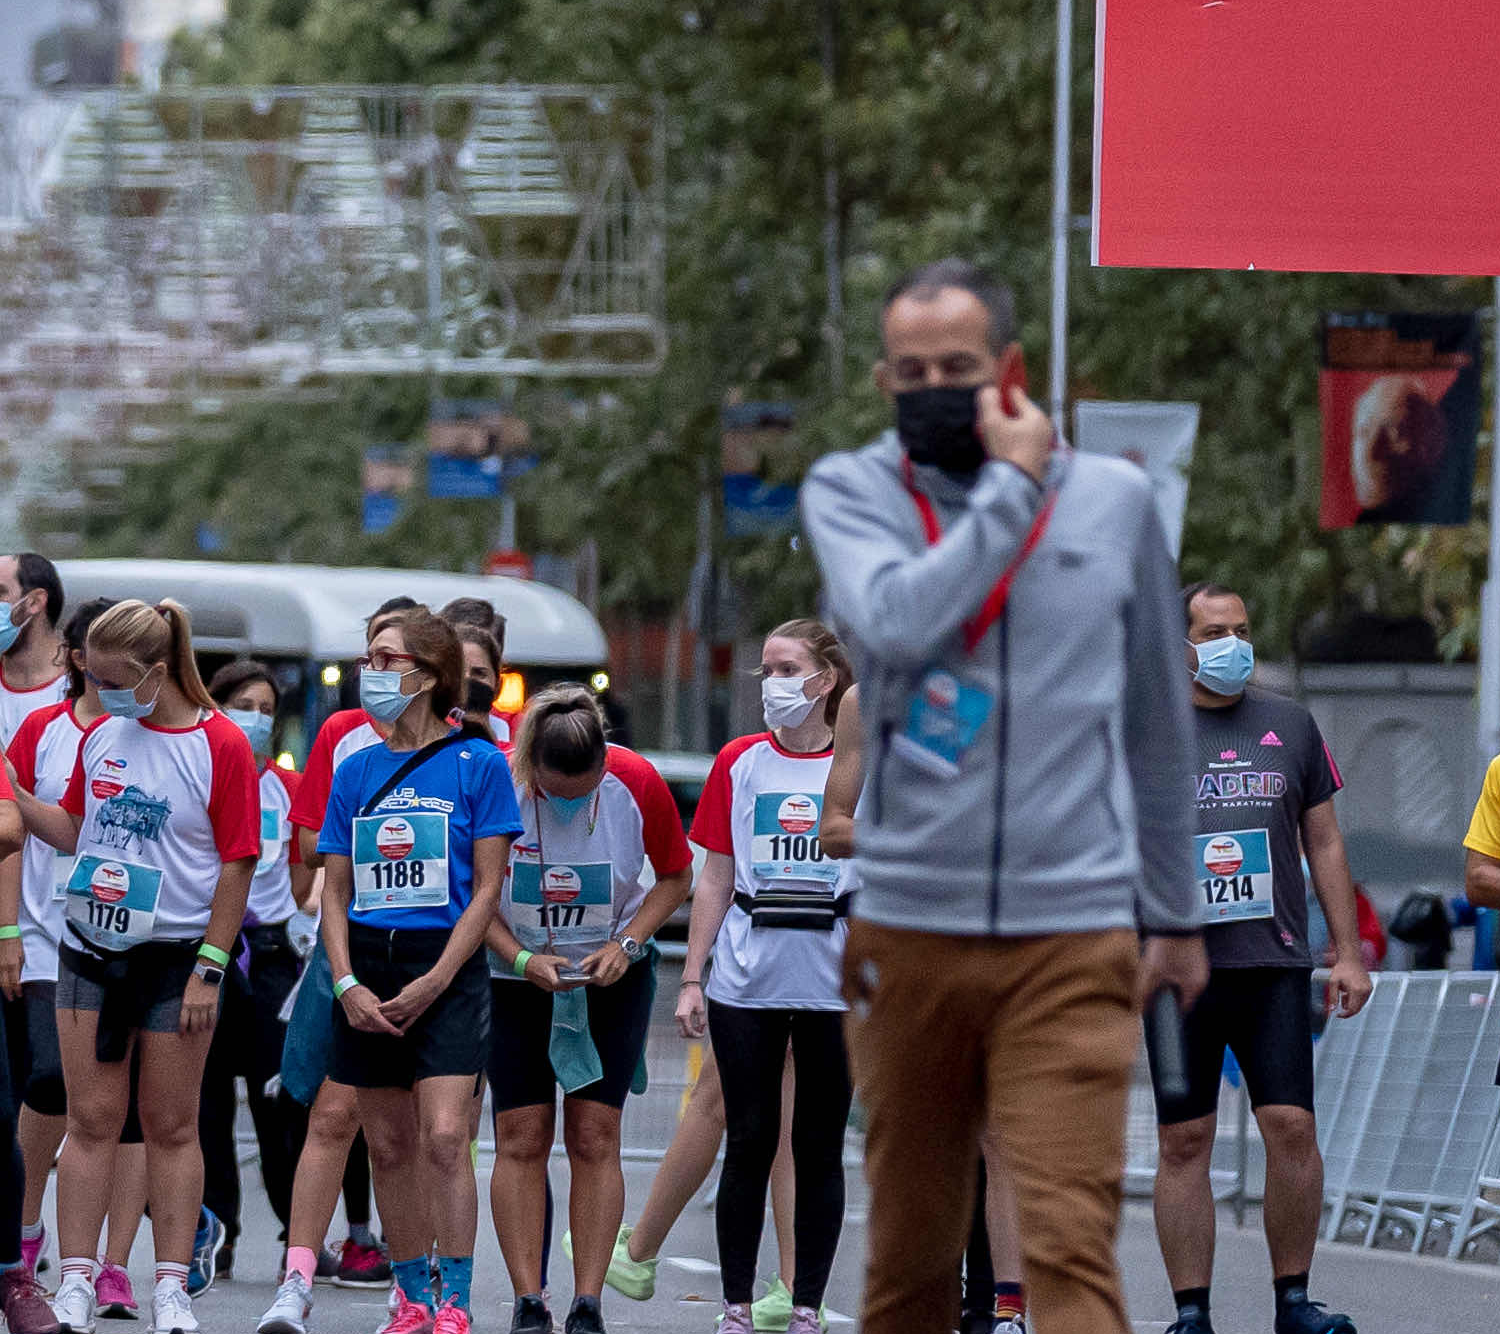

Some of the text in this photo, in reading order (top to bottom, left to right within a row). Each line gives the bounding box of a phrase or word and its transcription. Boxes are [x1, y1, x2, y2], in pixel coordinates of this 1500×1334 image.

[393, 787, 416, 798] UB
[1192, 771, 1288, 800] ADRID
[769, 835, 824, 863] 1100
[371, 860, 425, 890] 1188
[1201, 875, 1255, 905] 1214
[87, 900, 131, 934] 1179
[536, 904, 586, 927] 1177
